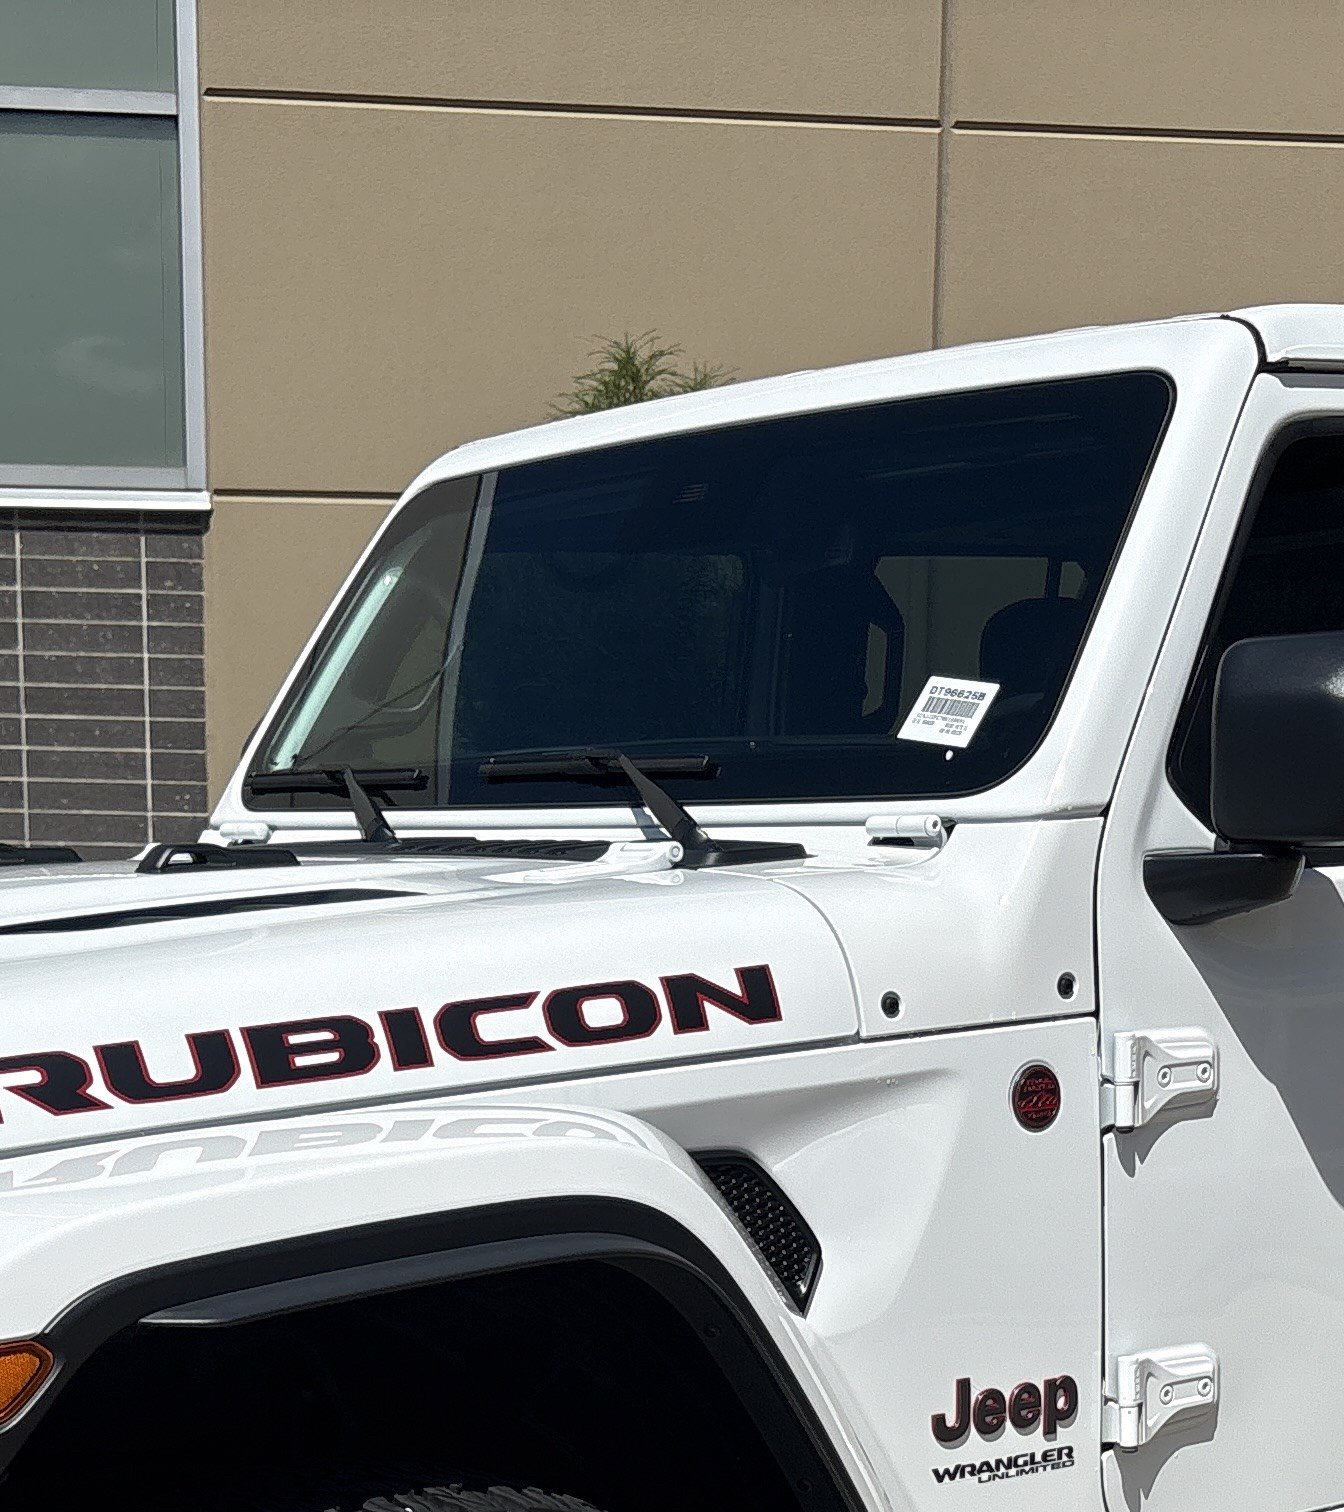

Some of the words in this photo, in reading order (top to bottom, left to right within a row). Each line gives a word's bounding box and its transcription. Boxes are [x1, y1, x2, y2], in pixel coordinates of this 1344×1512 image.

[931, 1374, 1078, 1443] Jeep
[931, 1445, 1075, 1484] WRANGLER
[977, 1458, 1075, 1484] UNLIMITED
